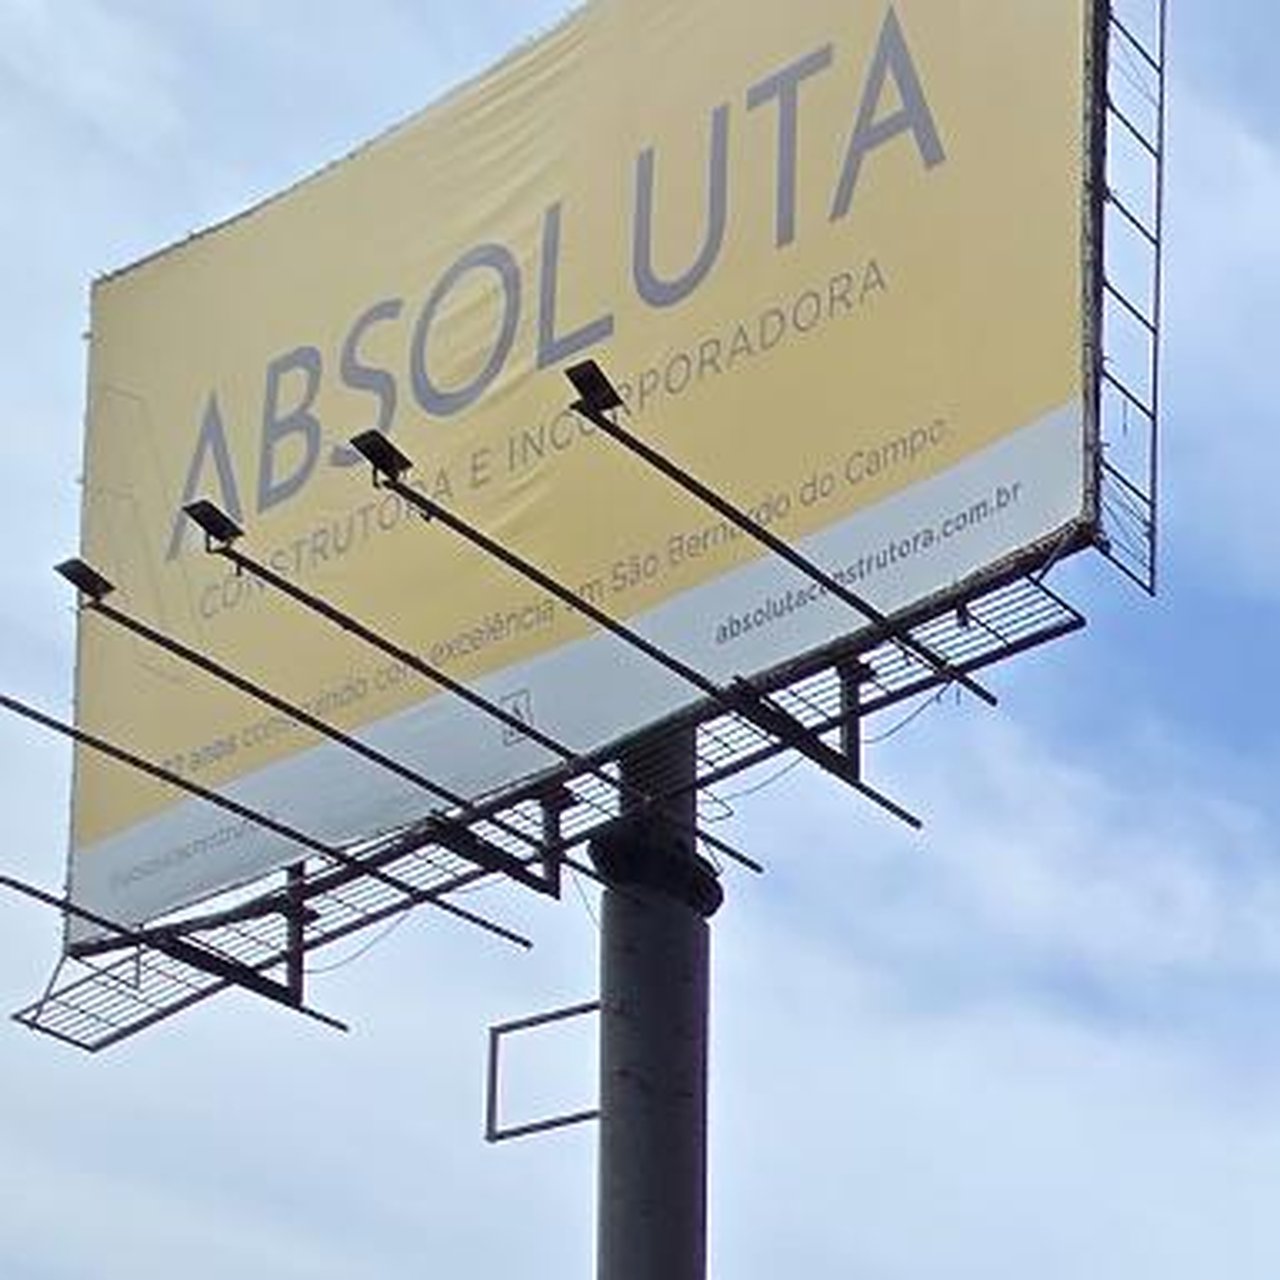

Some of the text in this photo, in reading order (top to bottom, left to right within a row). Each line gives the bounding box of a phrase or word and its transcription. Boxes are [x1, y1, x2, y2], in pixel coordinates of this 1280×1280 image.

[165, 4, 946, 562] ABSOLUTA
[470, 448, 492, 489] E
[611, 551, 659, 593] São
[668, 493, 791, 566] Berndo
[799, 475, 837, 507] do
[845, 418, 947, 484] Campo
